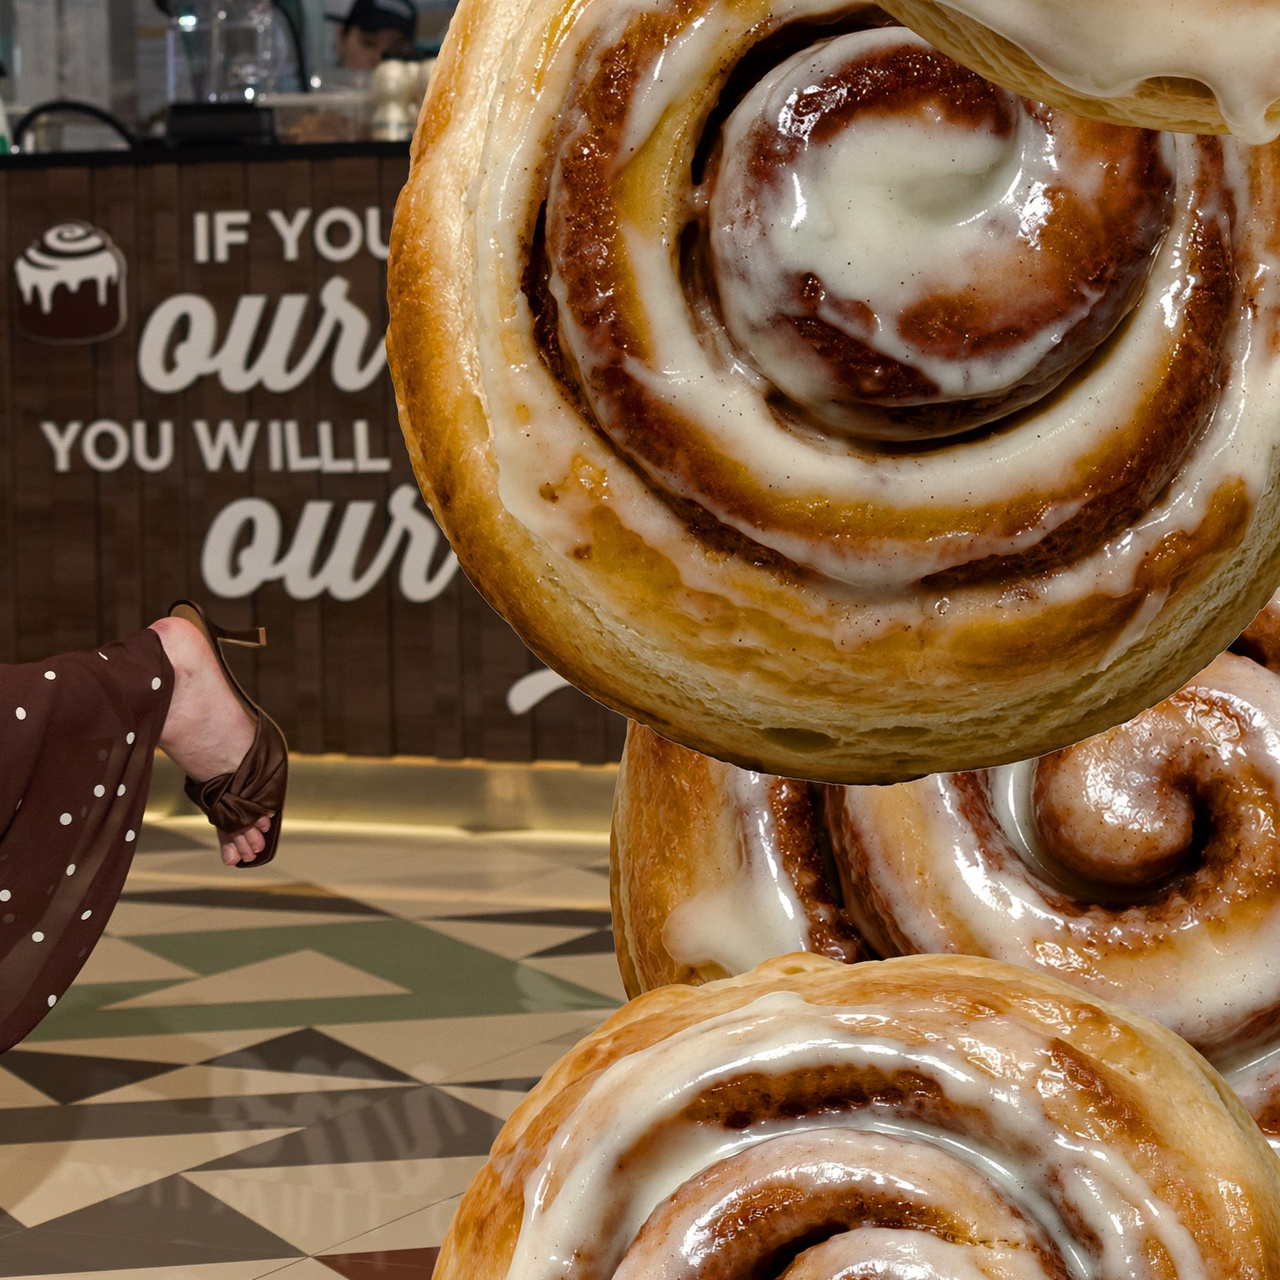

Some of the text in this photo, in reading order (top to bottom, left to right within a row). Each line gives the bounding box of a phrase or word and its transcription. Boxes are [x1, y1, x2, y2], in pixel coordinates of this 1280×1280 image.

[194, 211, 251, 263] IF
[137, 275, 388, 393] our
[41, 420, 174, 472] YOU
[201, 484, 460, 602] our
